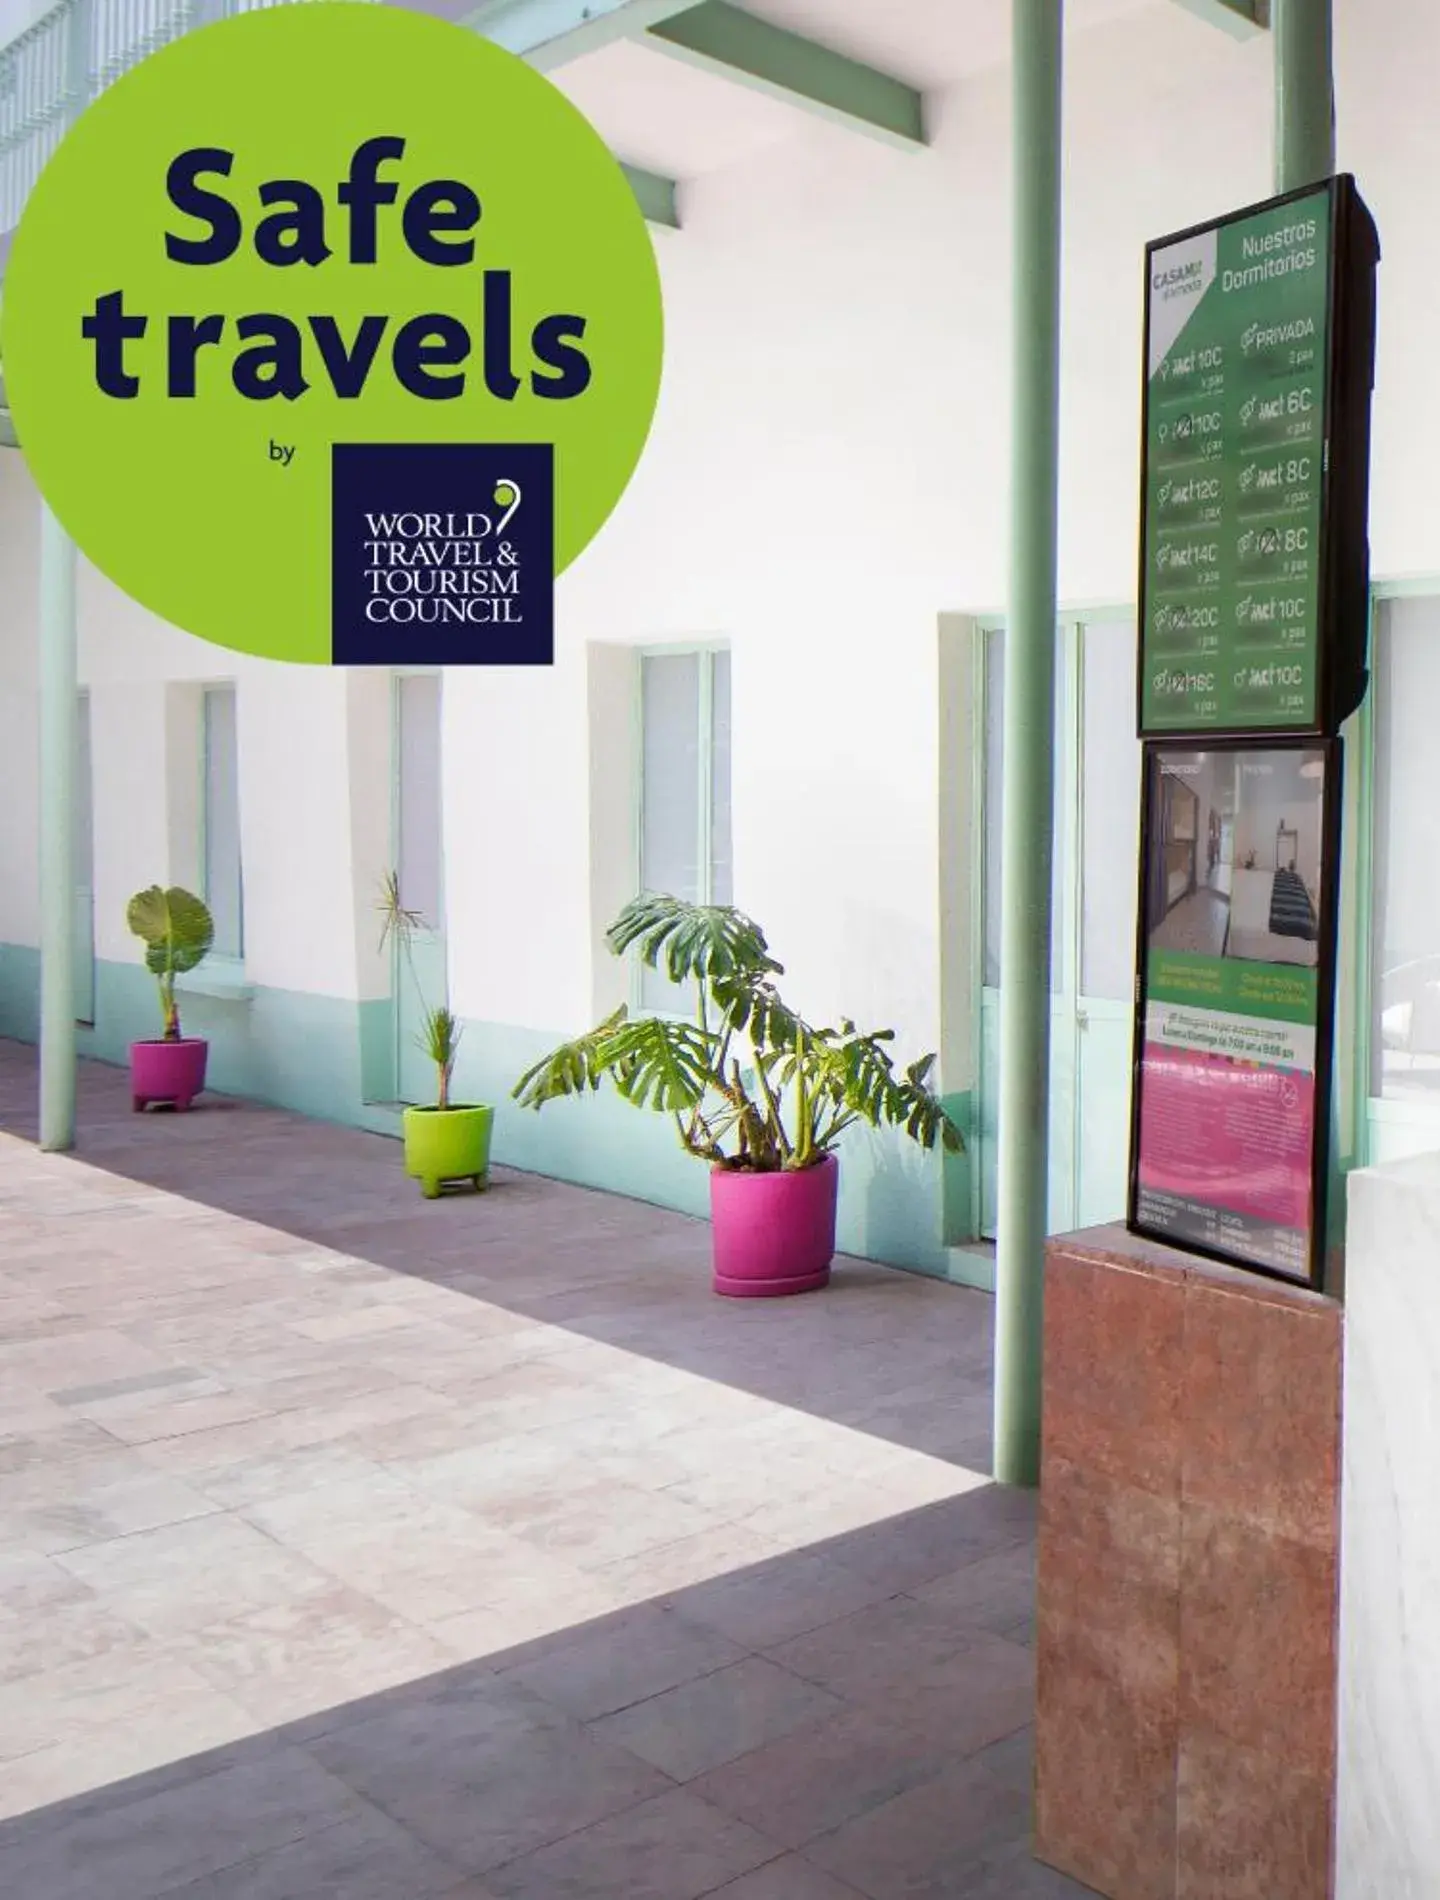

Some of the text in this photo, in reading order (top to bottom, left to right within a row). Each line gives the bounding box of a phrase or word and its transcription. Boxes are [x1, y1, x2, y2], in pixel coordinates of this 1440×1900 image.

[1242, 219, 1316, 259] Nuestros
[1222, 249, 1316, 292] Dormitorios
[1257, 316, 1315, 350] PRIVADA
[1287, 387, 1312, 414] 6C
[1286, 457, 1310, 483] 8C
[1285, 527, 1308, 552] 8C
[1279, 598, 1305, 618] 10C
